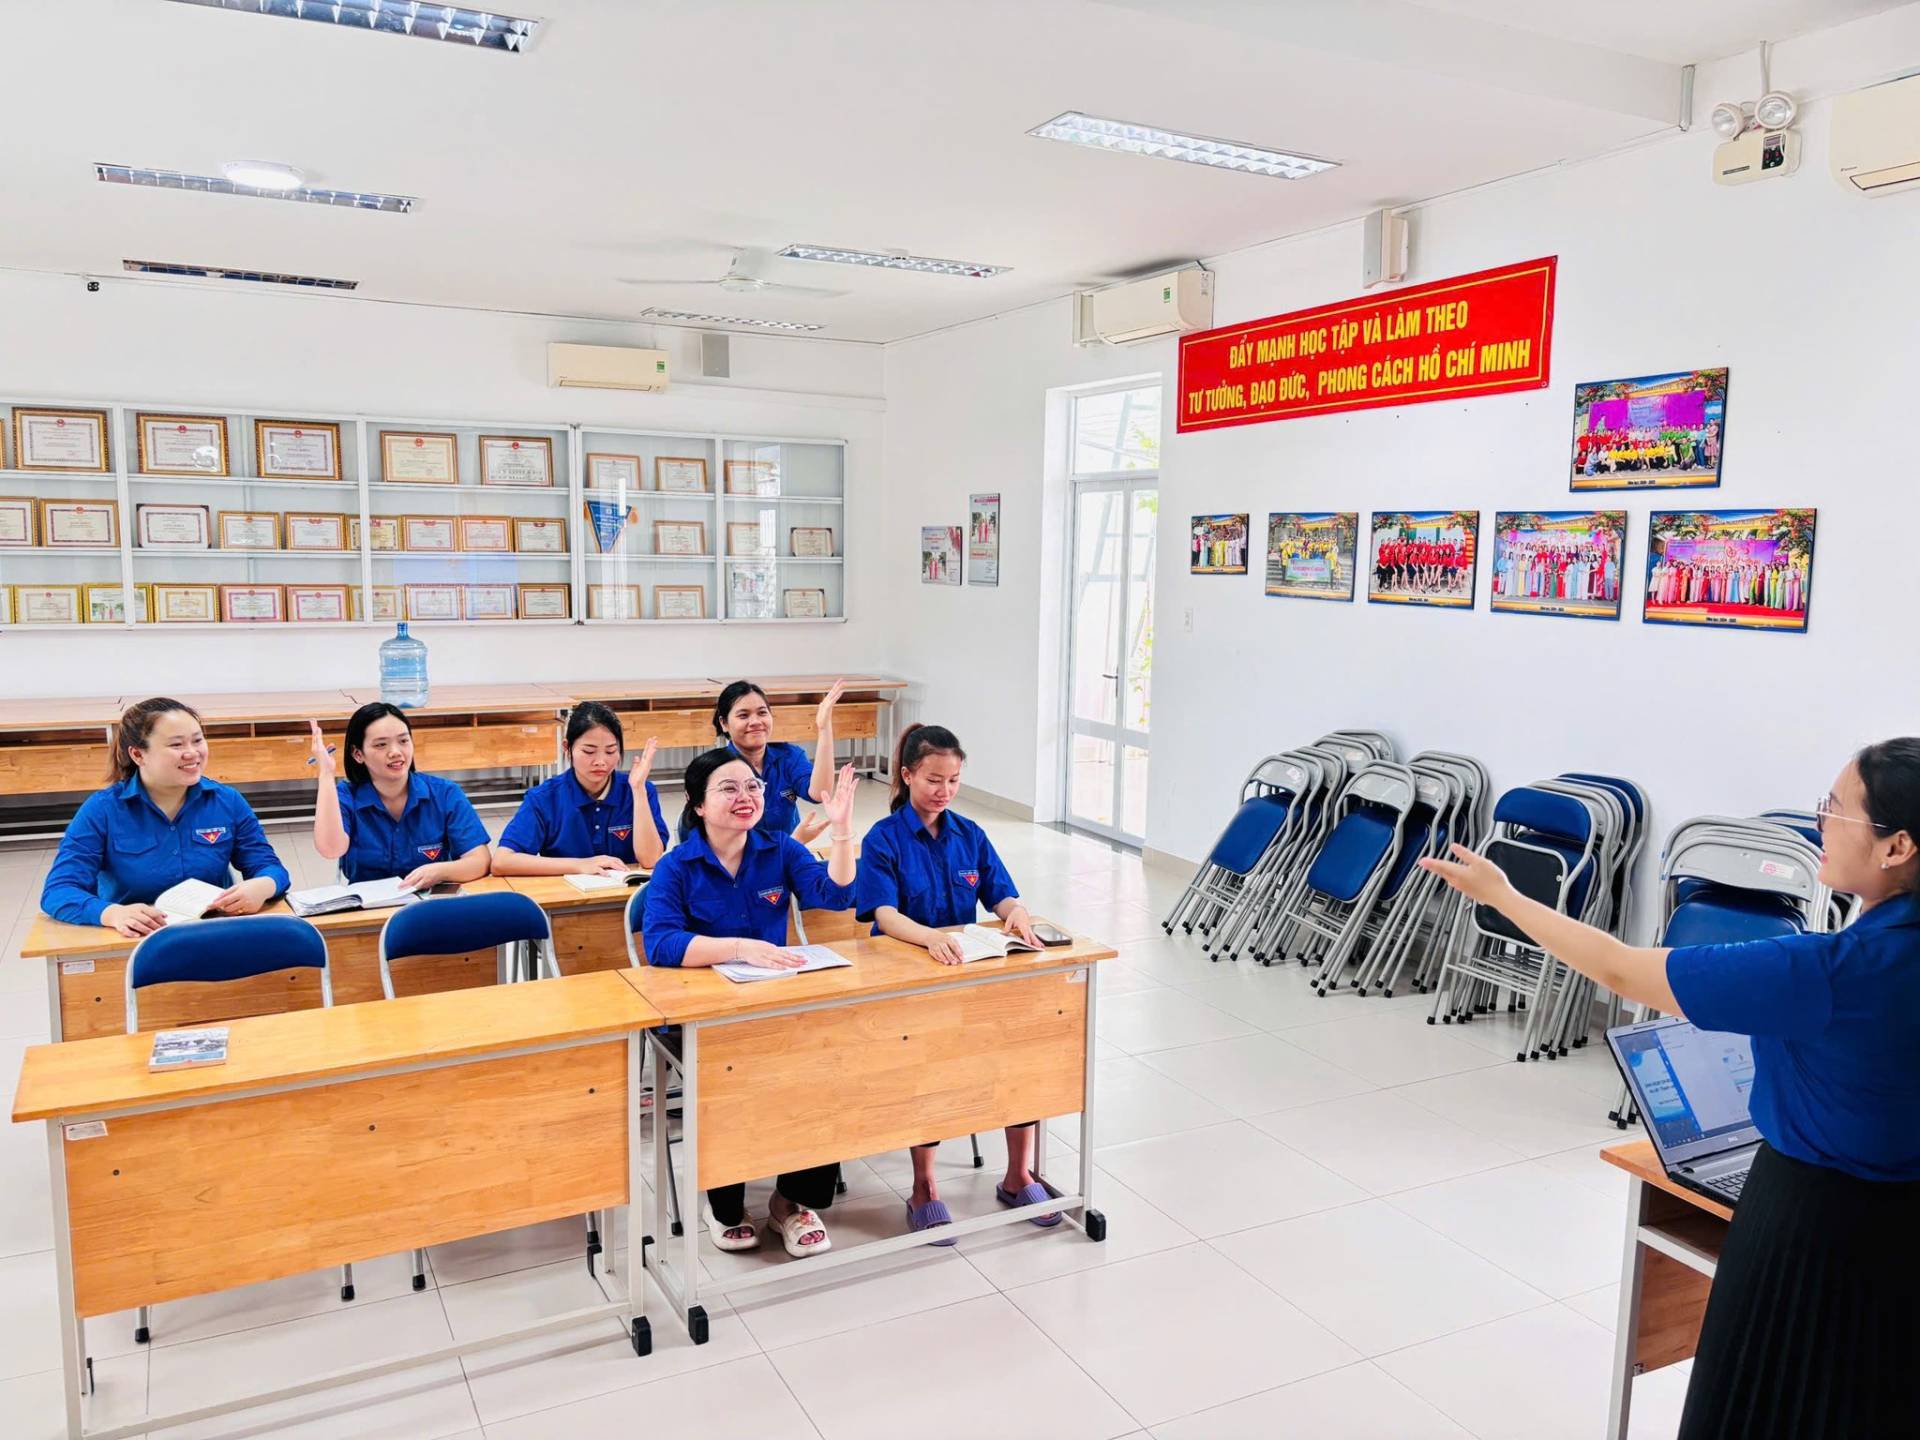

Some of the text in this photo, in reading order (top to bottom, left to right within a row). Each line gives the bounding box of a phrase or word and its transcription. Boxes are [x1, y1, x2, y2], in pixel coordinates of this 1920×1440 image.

[1256, 334, 1296, 367] MẠNH
[1300, 328, 1327, 360] HỌC
[1331, 318, 1359, 355] TẬP
[1362, 312, 1382, 345] VÀ
[1386, 306, 1422, 341] LÀM
[1426, 300, 1469, 334] THEO
[1188, 387, 1205, 415] TƯ
[1250, 379, 1277, 410] ĐẠO
[1279, 370, 1311, 401] ĐỨC,
[1317, 364, 1368, 396] PHONG
[1371, 355, 1414, 388] CÁCH
[1417, 343, 1441, 382] HỒ
[1445, 340, 1477, 378] CHÍ
[1480, 338, 1532, 374] MINH
